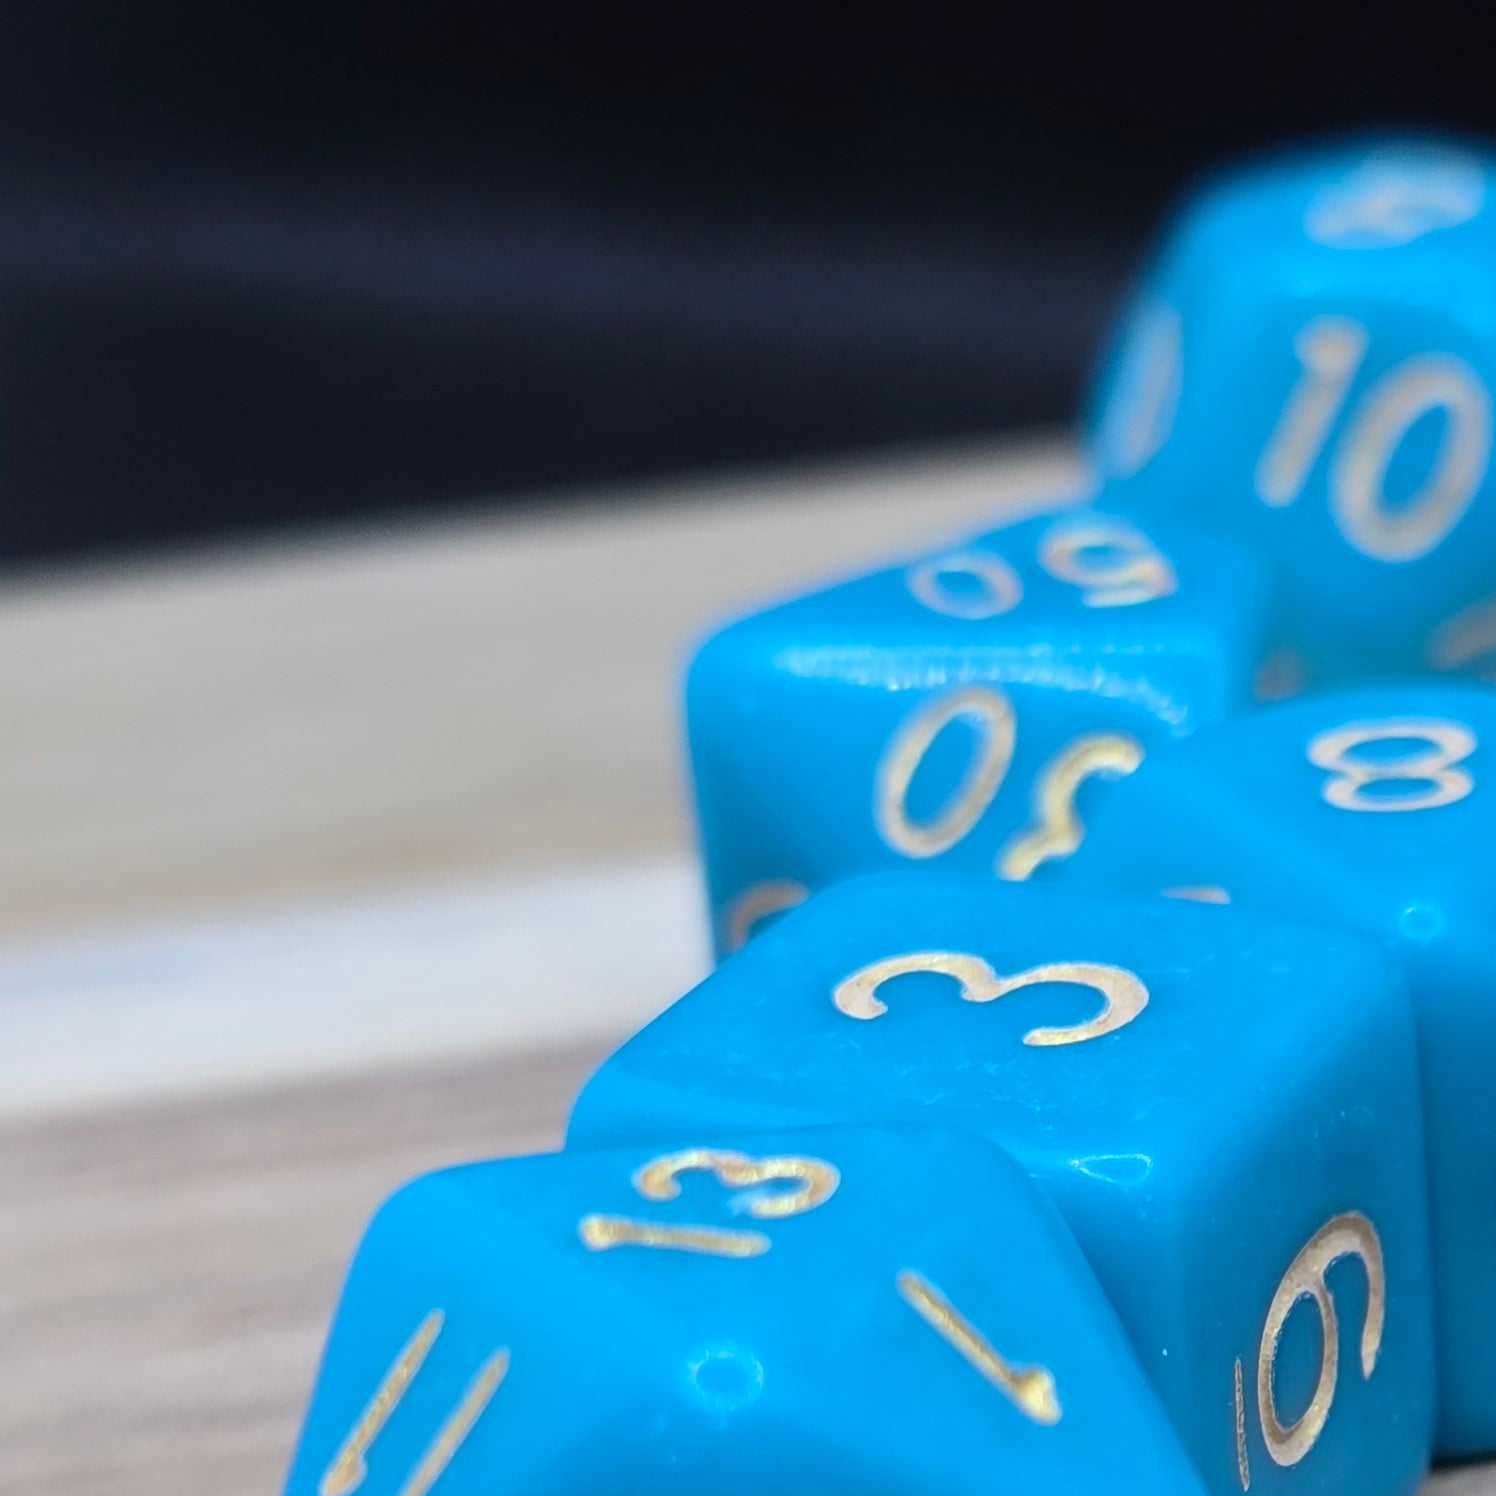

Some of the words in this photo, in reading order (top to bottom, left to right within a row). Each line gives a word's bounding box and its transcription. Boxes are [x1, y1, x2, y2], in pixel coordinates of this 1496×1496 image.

[1254, 315, 1493, 563] 10
[1307, 717, 1476, 812] 8
[833, 950, 1150, 1047] 3
[578, 1148, 841, 1260] 13
[896, 1268, 1062, 1426] 1
